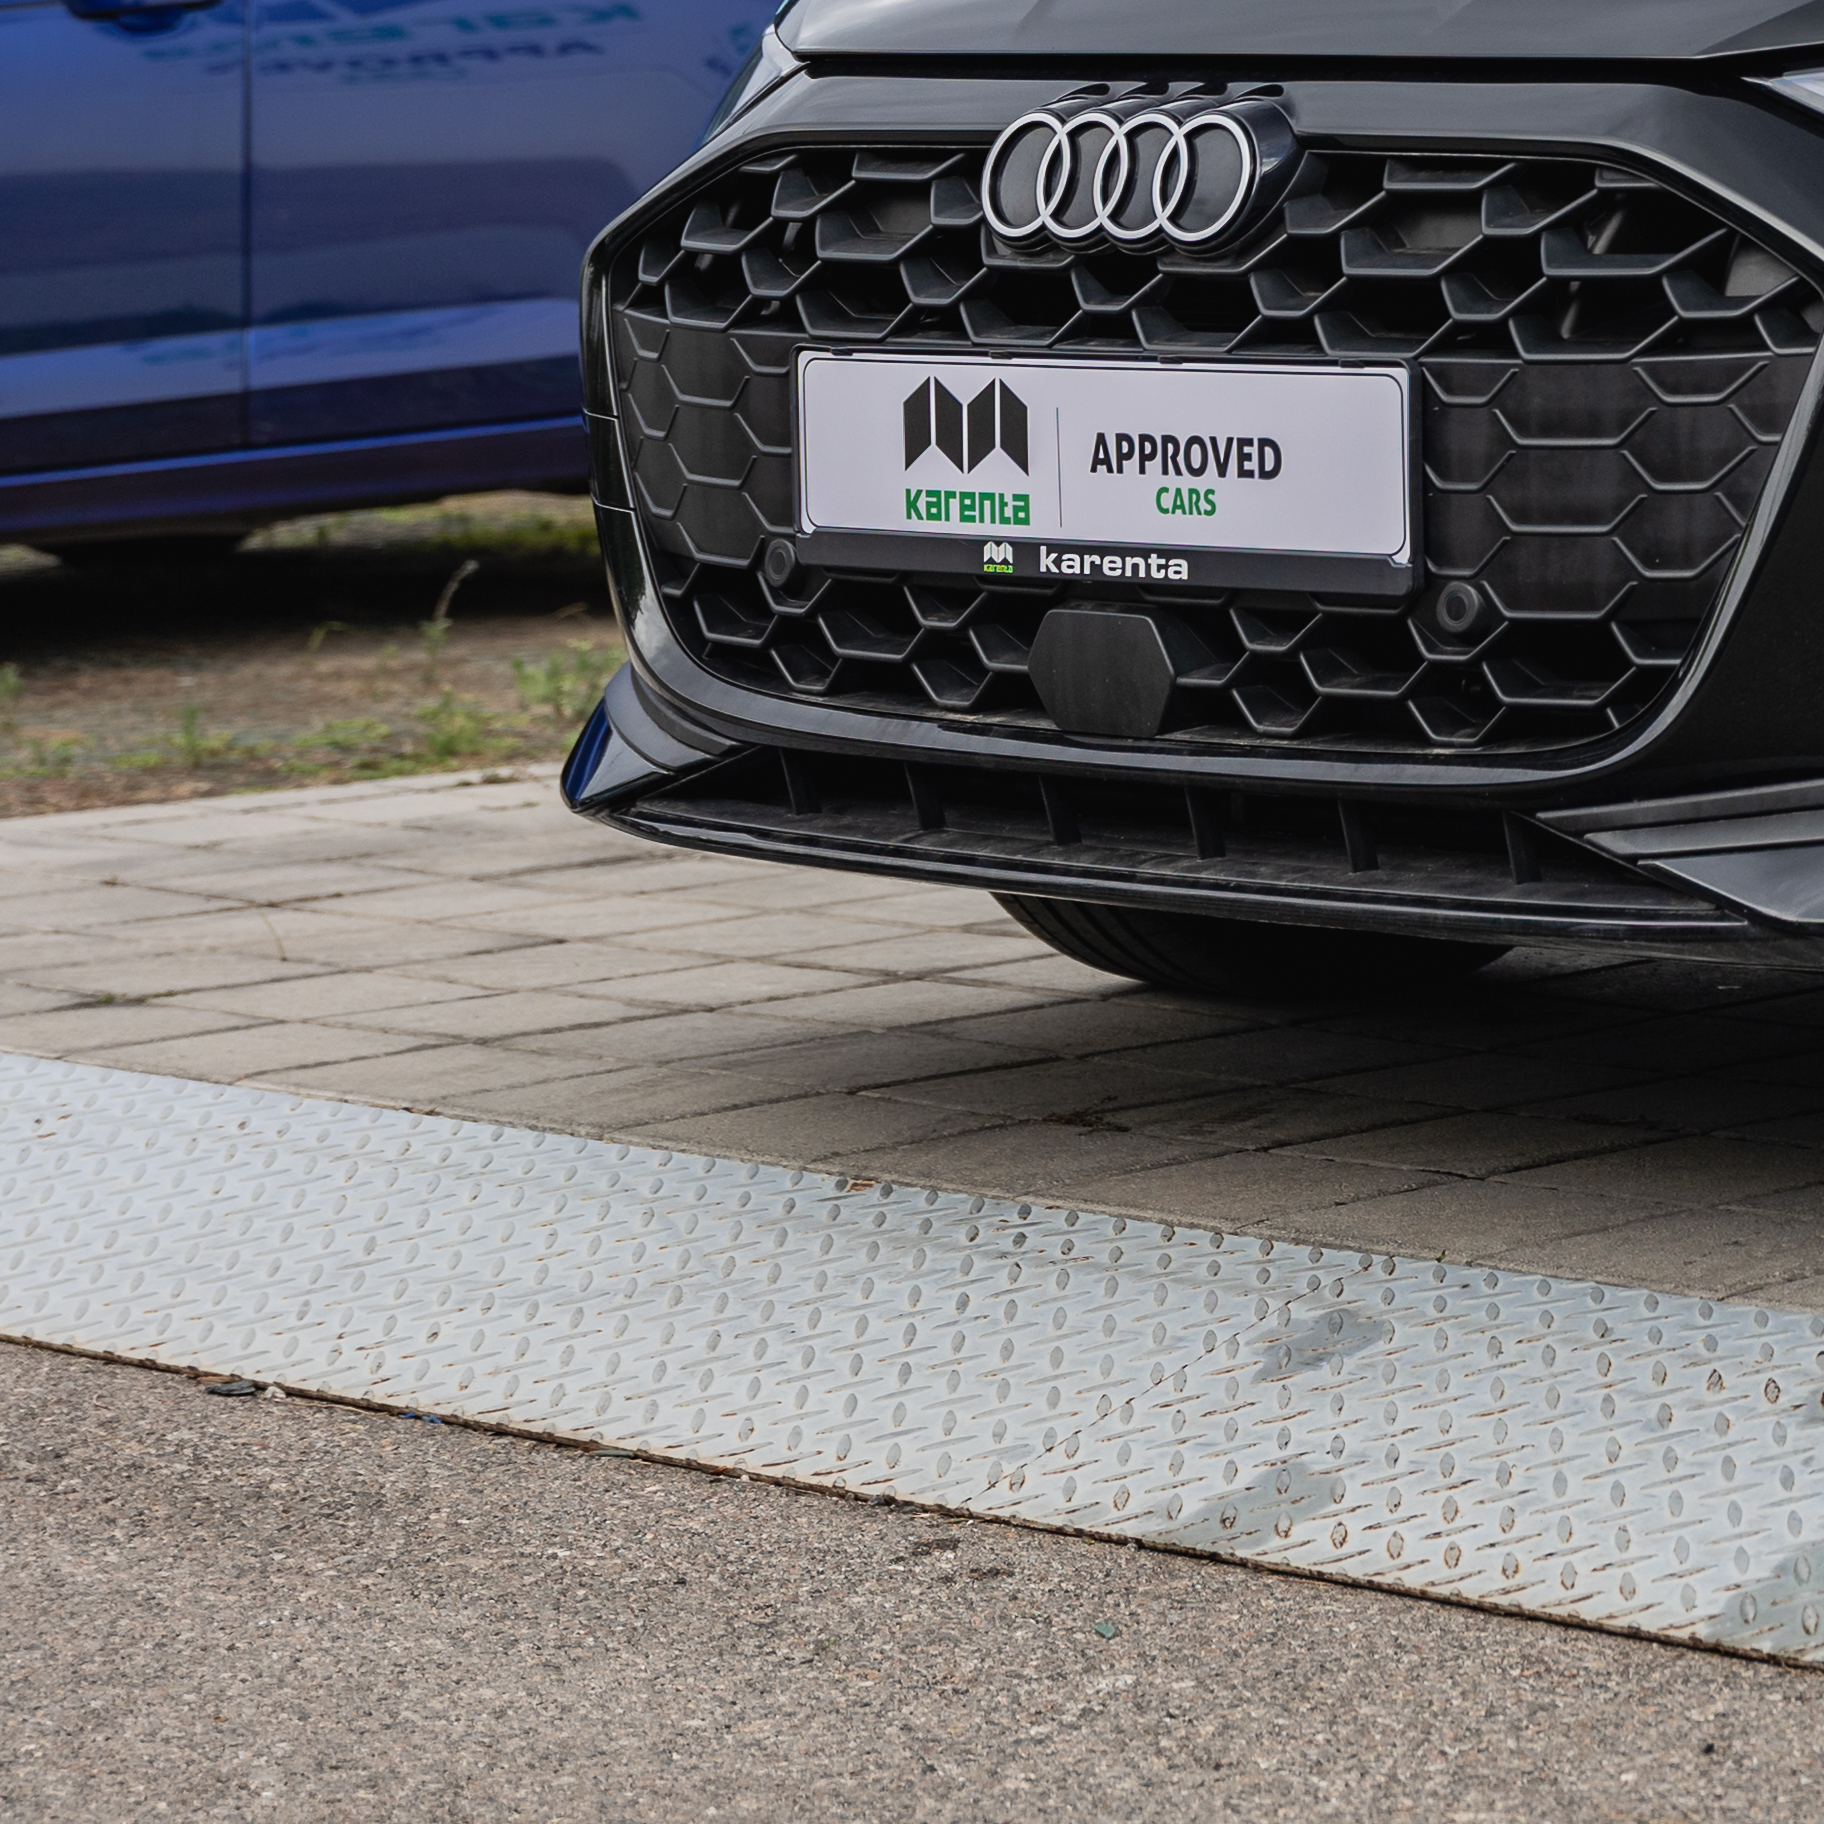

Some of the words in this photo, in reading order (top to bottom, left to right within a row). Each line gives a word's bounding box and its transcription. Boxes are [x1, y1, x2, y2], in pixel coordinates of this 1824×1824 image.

[1090, 432, 1283, 480] APPROVED
[1155, 486, 1217, 517] CARS
[1040, 545, 1189, 580] karenta
